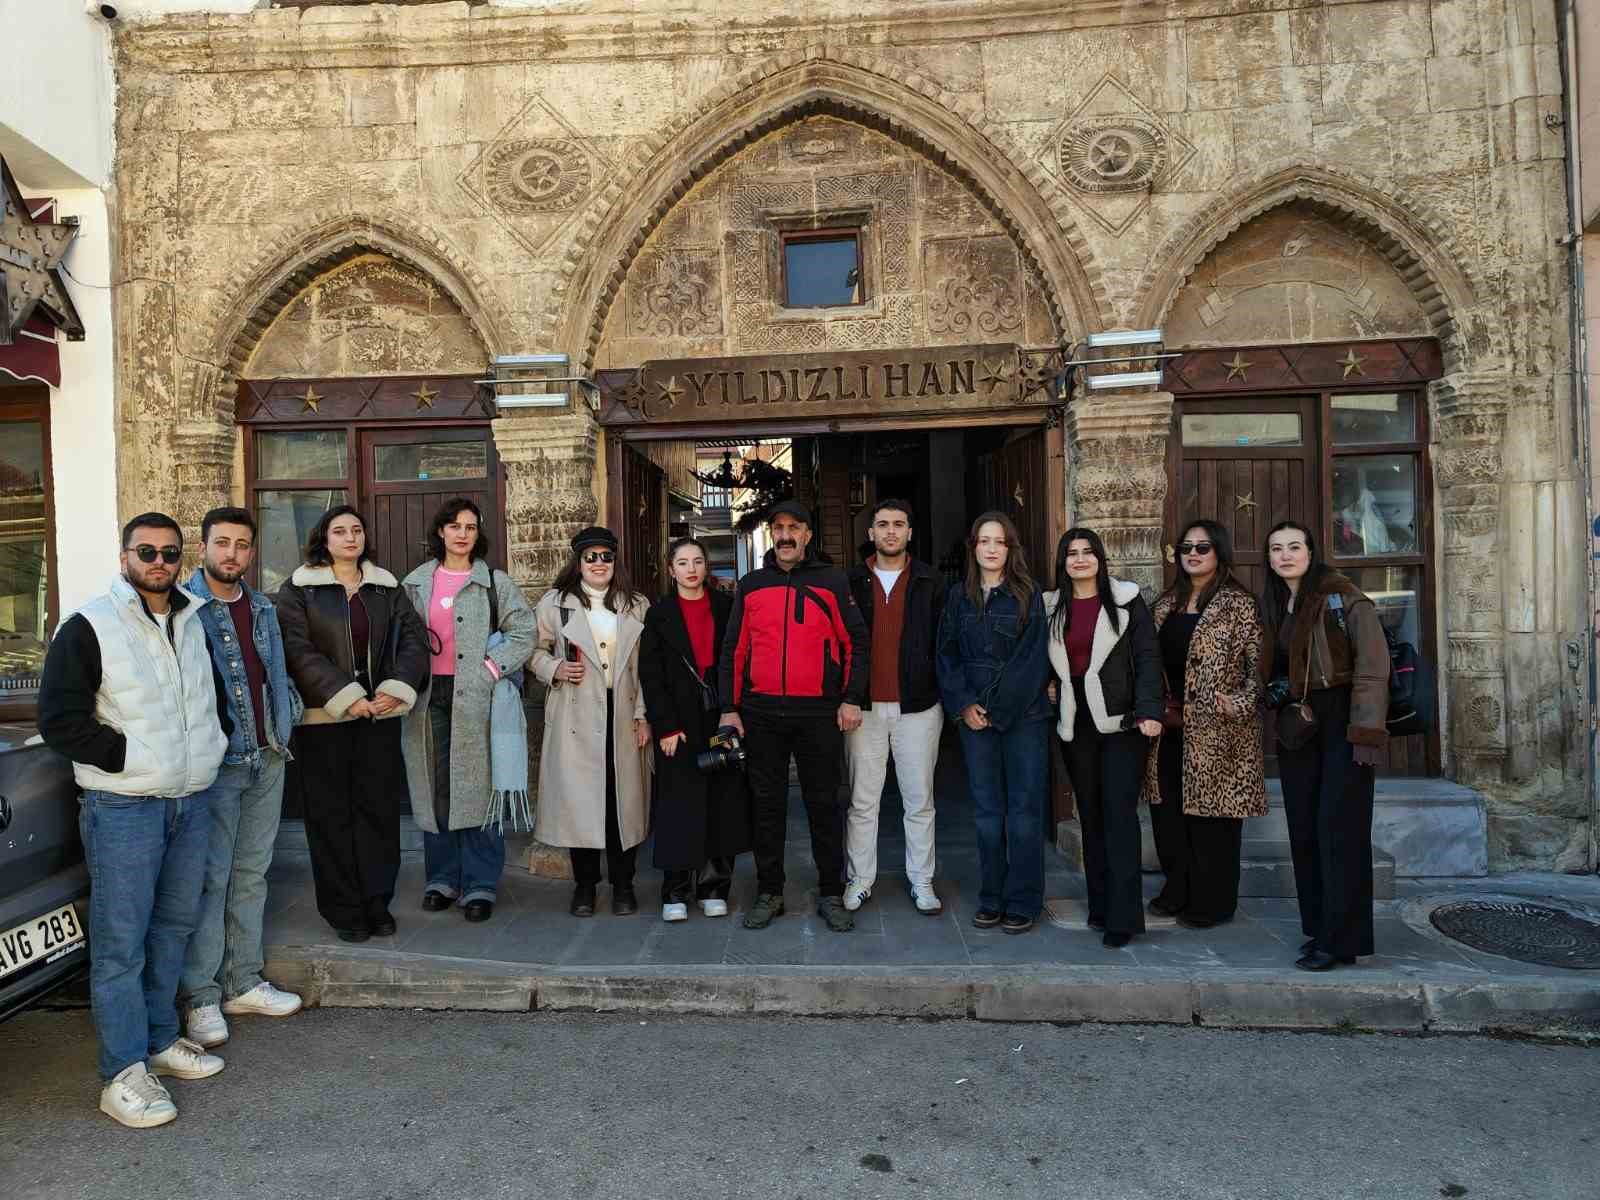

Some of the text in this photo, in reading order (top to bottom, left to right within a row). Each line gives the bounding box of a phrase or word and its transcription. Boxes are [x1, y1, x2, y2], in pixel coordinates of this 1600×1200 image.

[685, 359, 977, 406] YILDIZLI HAN
[38, 910, 77, 950] 283
